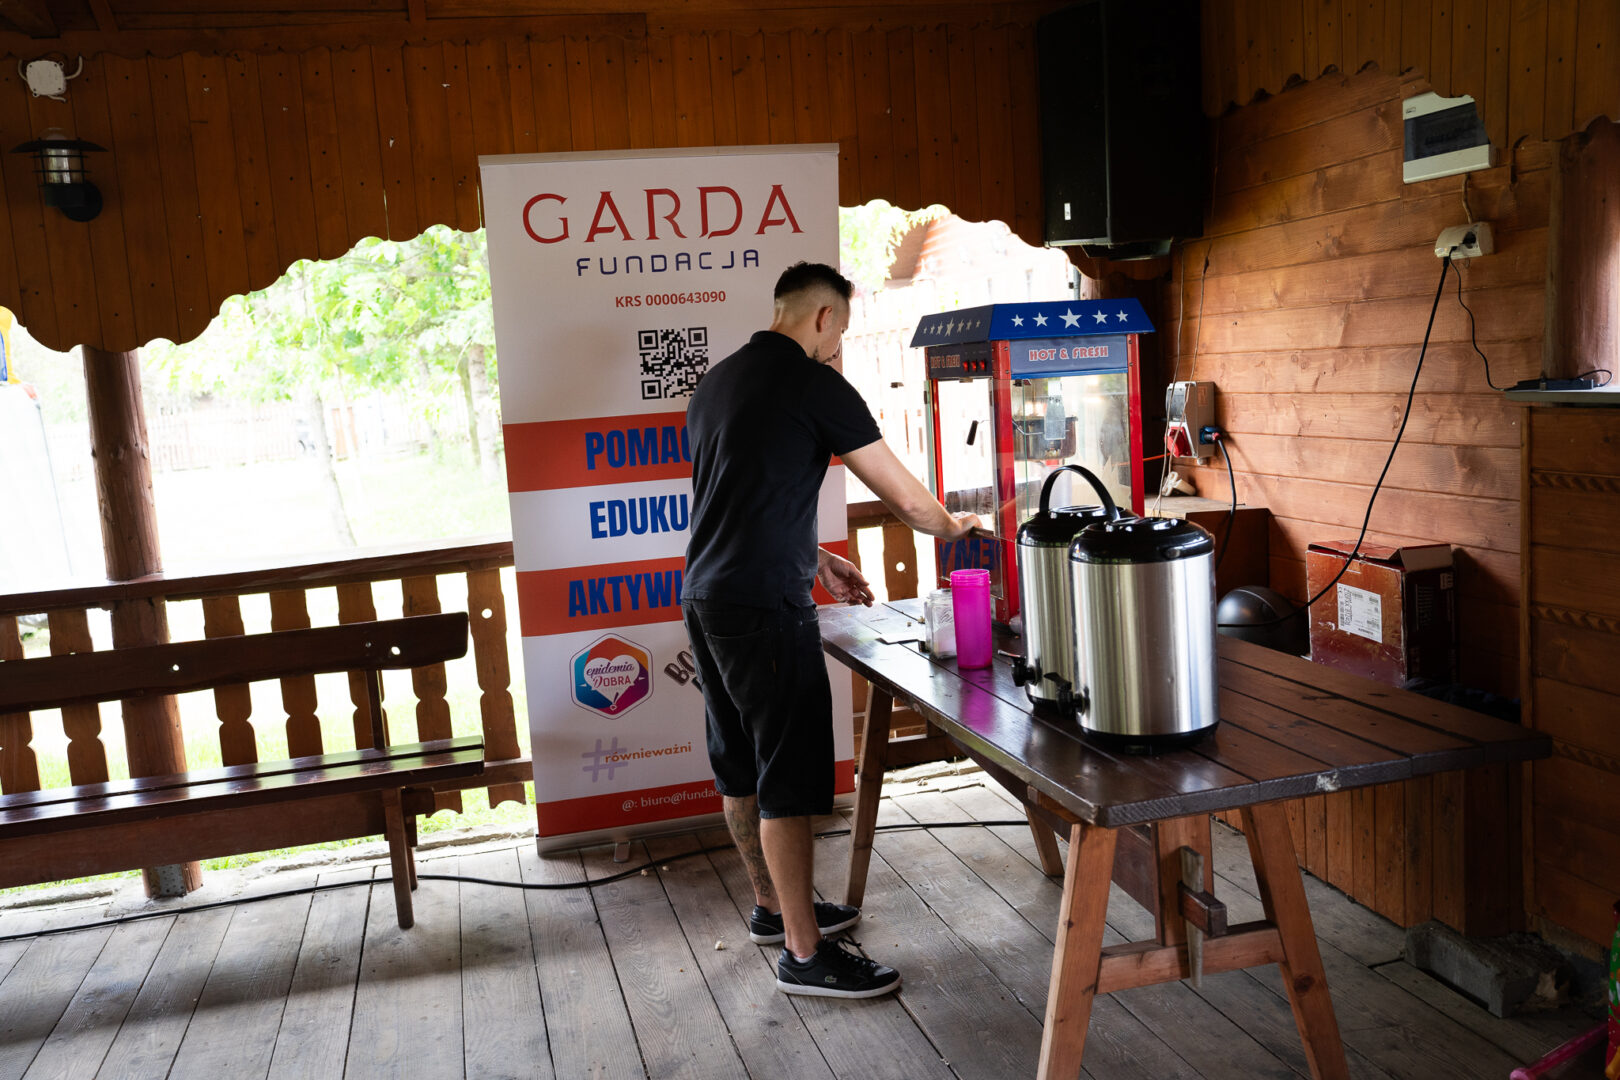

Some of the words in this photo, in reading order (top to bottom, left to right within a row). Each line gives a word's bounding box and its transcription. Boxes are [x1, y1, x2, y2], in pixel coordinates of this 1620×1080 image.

[522, 184, 804, 244] GARDA
[576, 249, 760, 277] FUNDACJA
[615, 294, 642, 308] KRS
[645, 290, 727, 307] 0000643090
[1028, 348, 1056, 362] HOT
[1060, 348, 1070, 360] &
[1073, 345, 1109, 359] FRESH
[589, 494, 692, 539] EDUKU
[586, 661, 635, 679] epidemia
[592, 675, 631, 688] DOBRA
